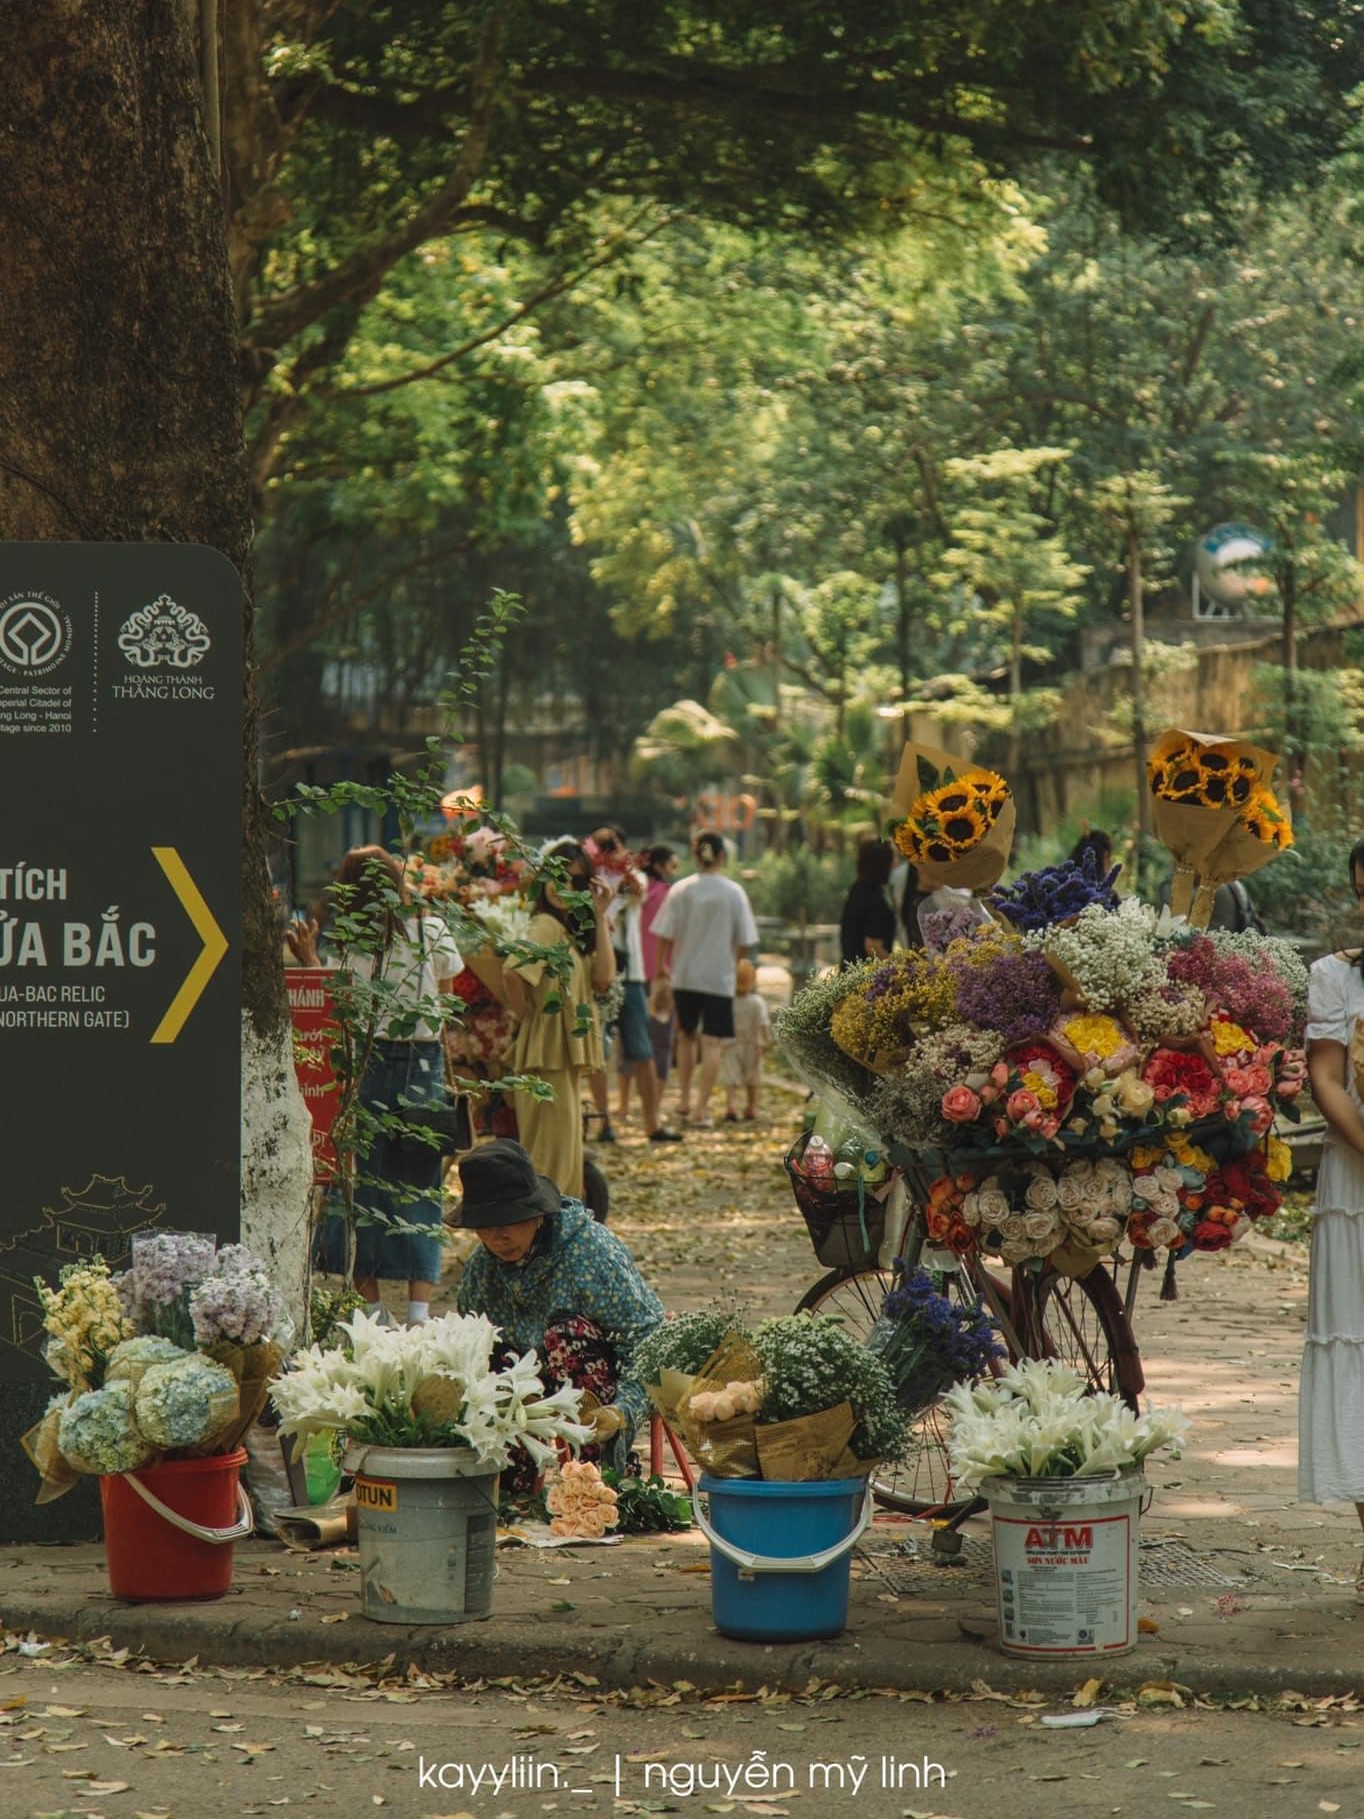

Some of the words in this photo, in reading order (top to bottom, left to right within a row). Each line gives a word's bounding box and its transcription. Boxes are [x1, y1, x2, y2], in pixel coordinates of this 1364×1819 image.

[31, 685, 61, 695] Sector
[62, 685, 73, 695] of
[112, 683, 169, 699] THĂNG
[172, 685, 216, 700] LONG
[0, 698, 27, 709] perial
[29, 698, 61, 708] Citadel
[62, 698, 73, 708] of
[14, 711, 37, 722] Long
[45, 710, 72, 720] Hanoi
[23, 723, 47, 733] since
[48, 723, 72, 733] 2010
[0, 861, 67, 900] TÍCH
[63, 905, 156, 968] BẮC
[61, 985, 105, 1003] RELIC
[1025, 1527, 1092, 1548] ATM
